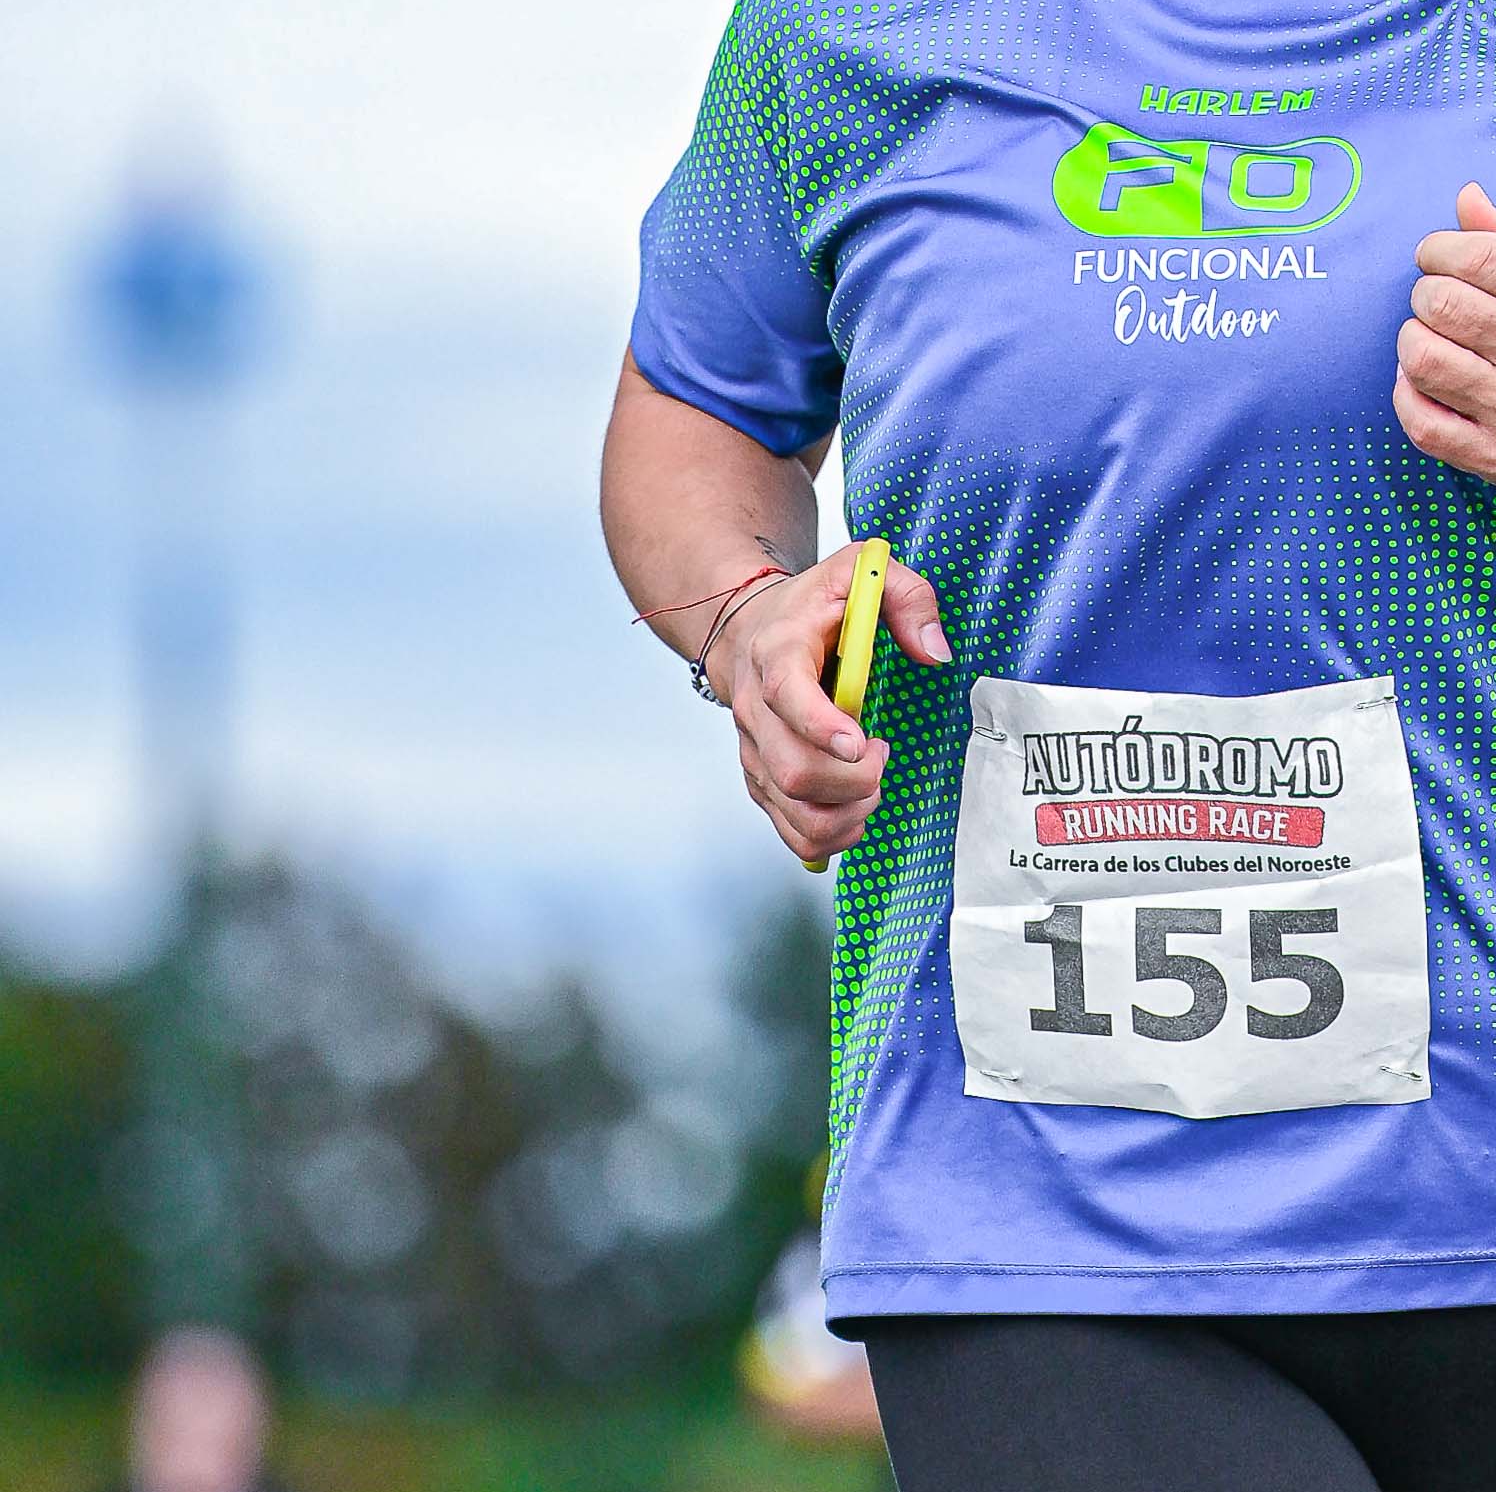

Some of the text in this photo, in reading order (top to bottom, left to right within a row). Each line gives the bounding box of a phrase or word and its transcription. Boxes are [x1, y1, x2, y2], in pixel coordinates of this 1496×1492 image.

[1139, 84, 1315, 115] HARLEM
[1073, 245, 1328, 284] FUNCIONAL
[1113, 285, 1281, 345] Outdoor
[1023, 715, 1344, 798] AUTÓDROMO
[1062, 803, 1289, 842] RUNNING RACE
[1009, 849, 1351, 873] La Carrera de los Clubes del Noroeste
[1023, 904, 1345, 1042] 155
